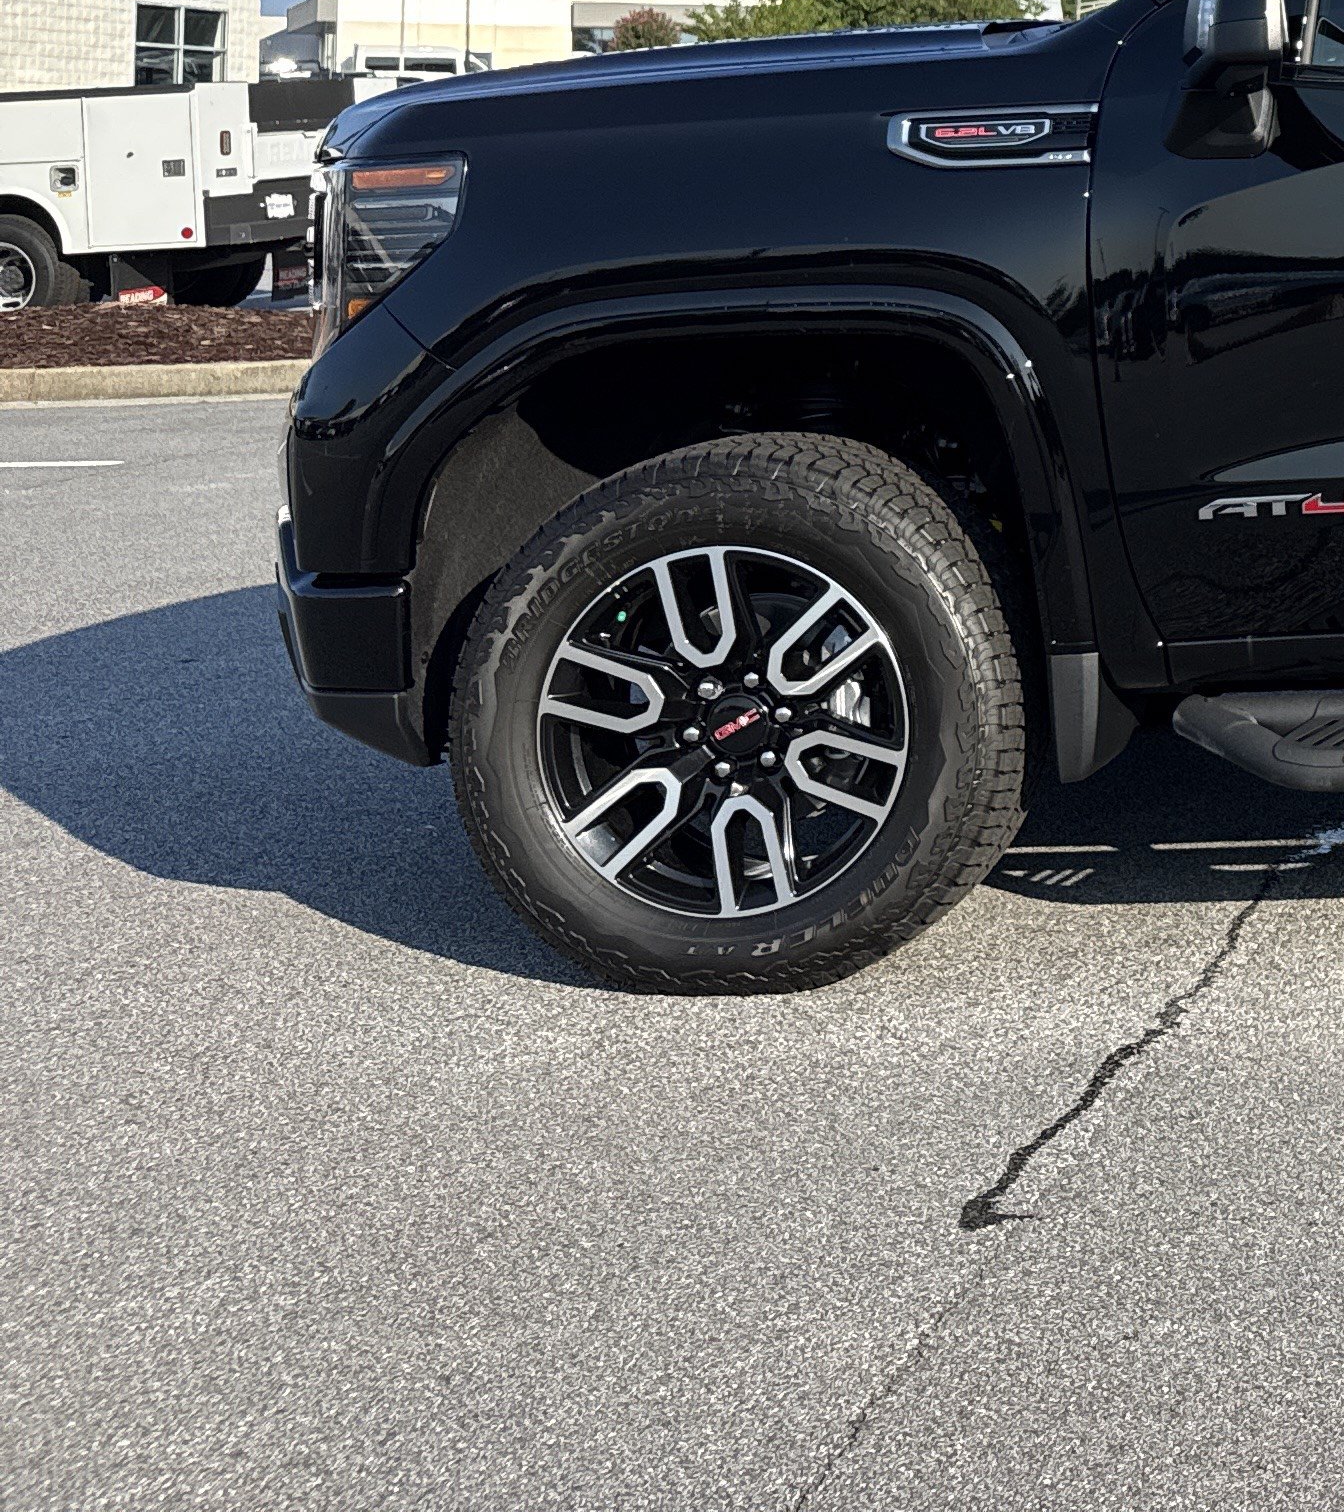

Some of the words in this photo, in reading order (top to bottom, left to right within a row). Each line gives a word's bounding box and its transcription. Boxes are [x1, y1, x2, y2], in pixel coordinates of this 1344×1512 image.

[934, 126, 998, 138] 6.2L
[997, 125, 1036, 135] V8
[714, 708, 761, 741] GMC
